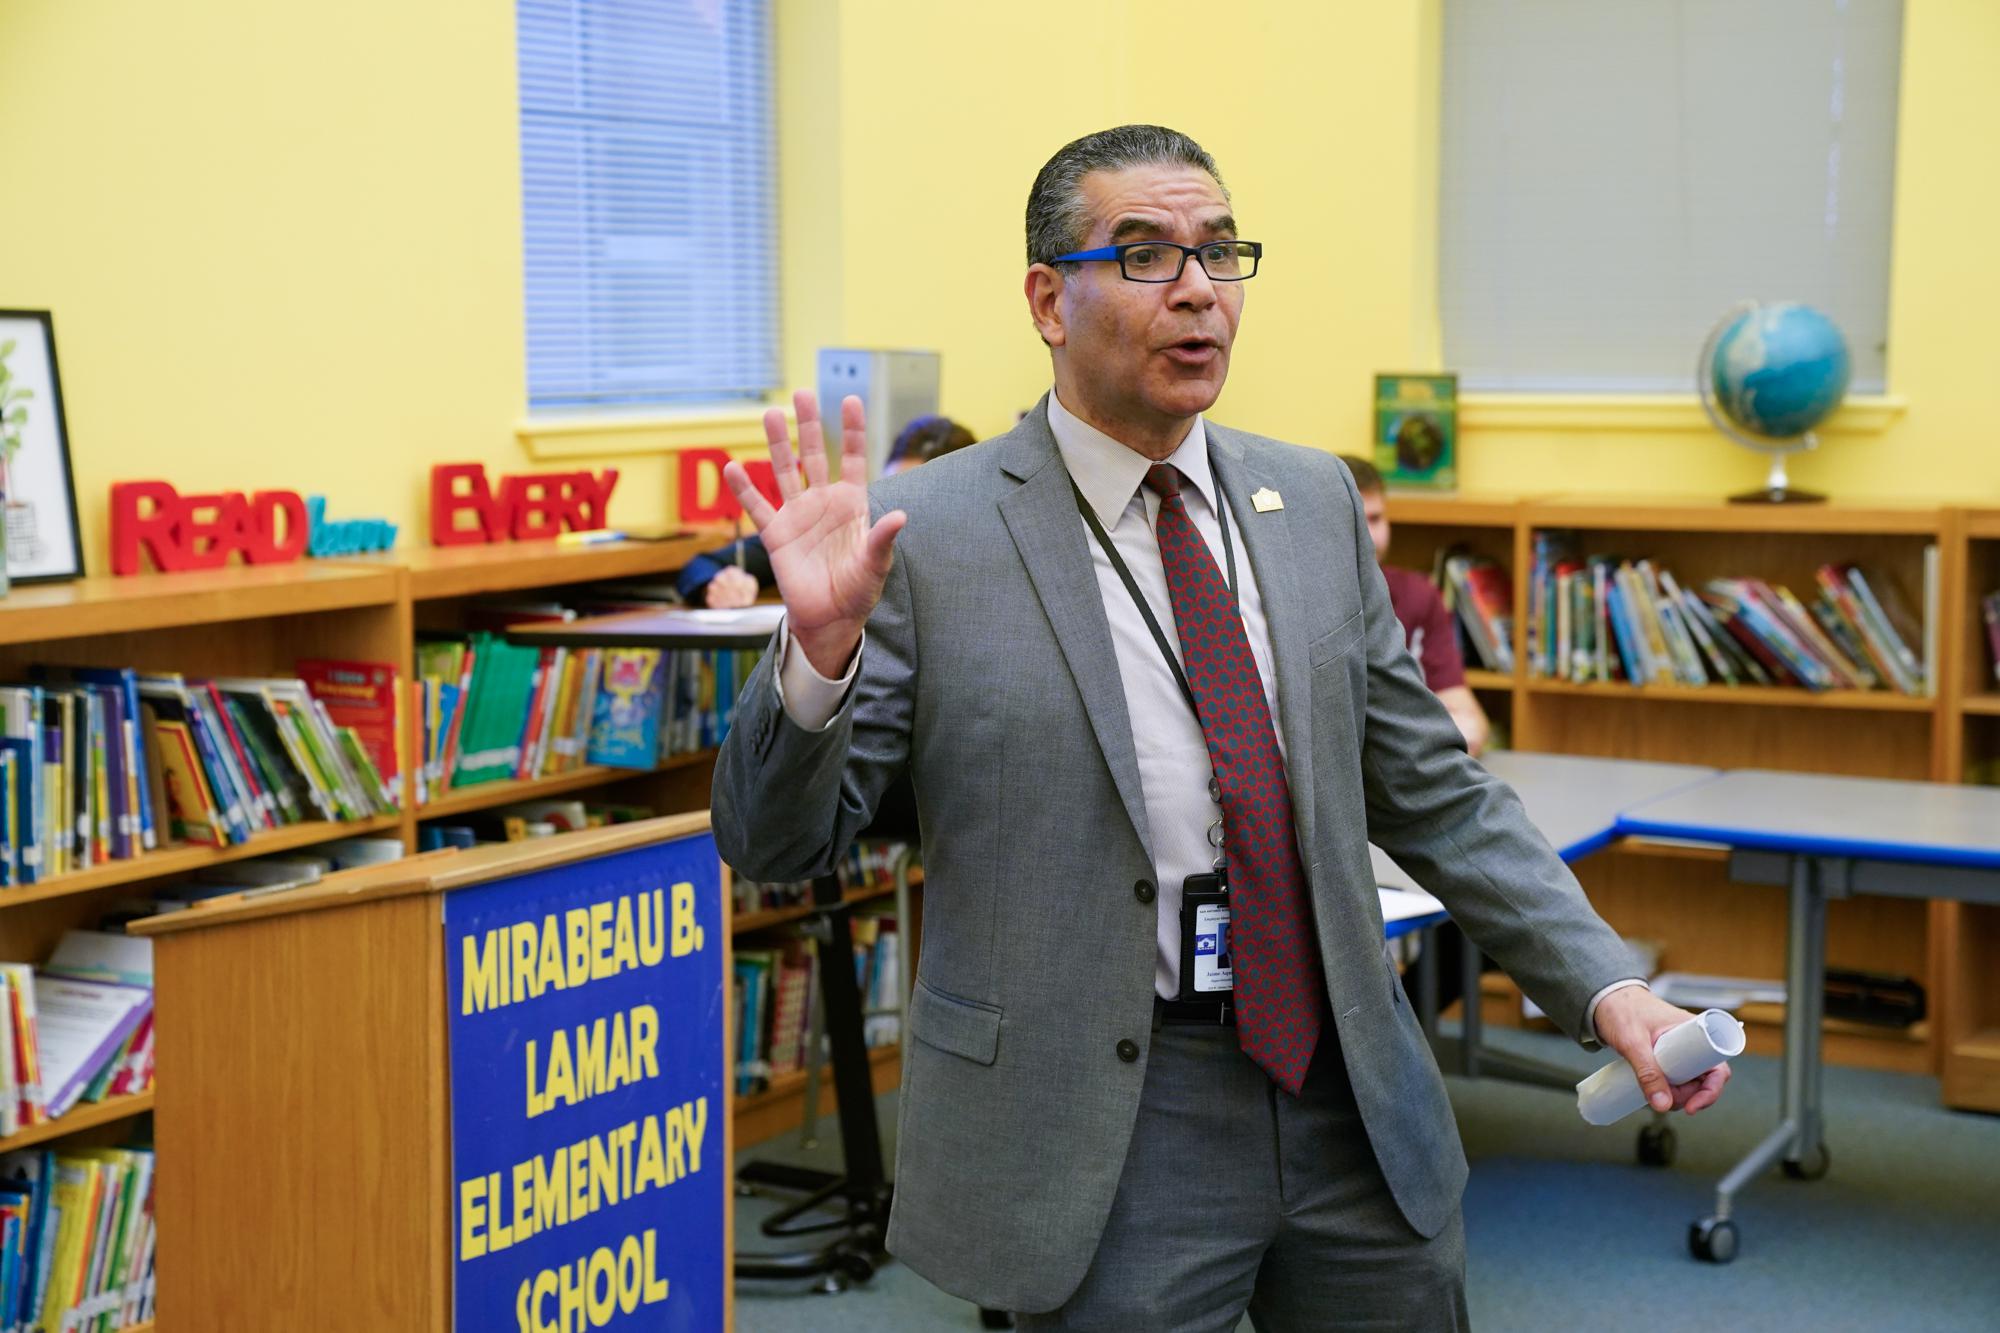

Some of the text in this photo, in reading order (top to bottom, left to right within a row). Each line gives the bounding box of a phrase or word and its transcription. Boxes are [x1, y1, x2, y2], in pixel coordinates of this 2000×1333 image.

[110, 482, 308, 577] READ
[429, 463, 619, 546] EVERY
[462, 881, 705, 1016] MIRABEAU B.
[526, 1004, 660, 1119] LAMAR
[460, 1097, 708, 1262] ELEMENTARY
[516, 1228, 669, 1333] SCHOOL
